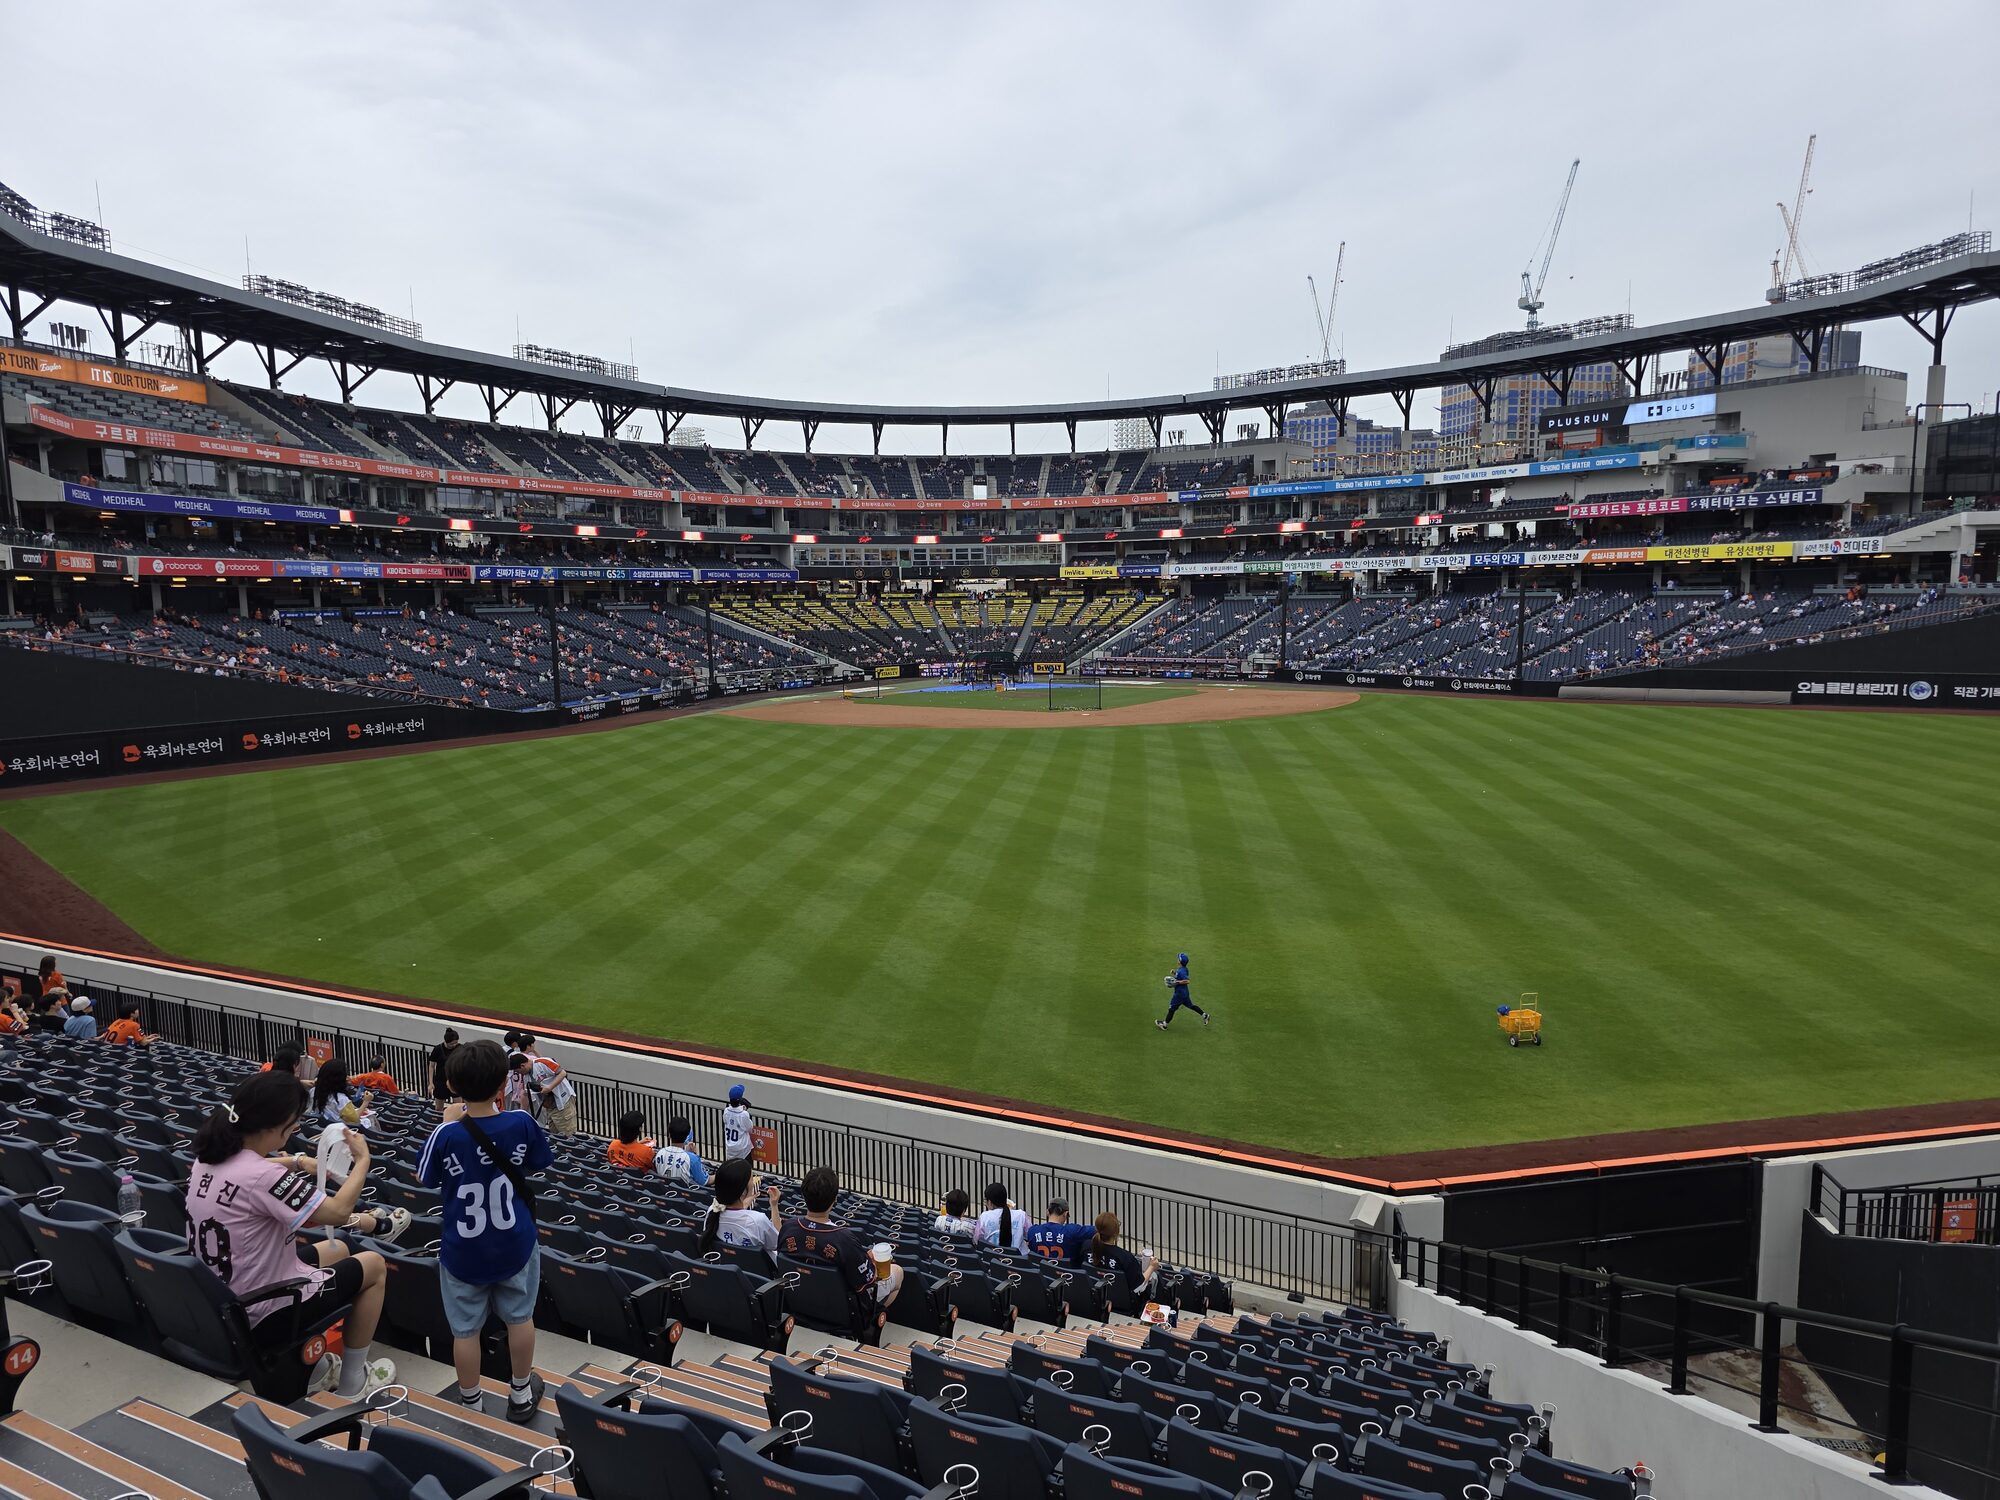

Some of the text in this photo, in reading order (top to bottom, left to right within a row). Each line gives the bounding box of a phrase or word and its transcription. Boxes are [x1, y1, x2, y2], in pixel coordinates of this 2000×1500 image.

[8, 353, 38, 372] TURN
[90, 368, 160, 392] IT IS OUR TURN
[1666, 403, 1696, 413] PLUS
[1540, 464, 1560, 472] BEYOND
[1572, 461, 1591, 470] WATER
[1443, 473, 1461, 482] BEYOND
[1470, 471, 1488, 479] WATER
[1336, 481, 1354, 490] BEYOND
[72, 489, 92, 501] MEDIHEAL
[102, 495, 146, 507] MEDIHEAL
[1699, 490, 1817, 509] 워터마크는 스냅태그
[174, 500, 213, 512] MEDIHEAL
[237, 506, 272, 516] MEDIHEAL
[1579, 500, 1680, 516] 포토카드는 포토코드
[295, 510, 327, 520] MEDIHEAL
[1664, 546, 1709, 558] 대전선병원
[1724, 544, 1775, 557] 유성선병원
[1804, 544, 1817, 554] 60년
[1843, 540, 1880, 553] 한미타올
[1424, 556, 1466, 566] 모두의 안과
[1474, 554, 1520, 565] 모두의 안과
[164, 562, 203, 570] roborock
[226, 563, 261, 571] roborock
[444, 567, 468, 578] TVING
[515, 569, 526, 578] 되는
[527, 569, 539, 578] 시간
[606, 570, 626, 578] GS25
[1414, 679, 1434, 688] 한화오션
[1797, 682, 1898, 696] 오늘 클립 챌린지
[1954, 686, 1978, 698] 직관
[363, 718, 425, 736] 육회바른연어
[260, 727, 331, 747] 육회바른연어
[144, 737, 224, 758] 육회바른연어
[8, 750, 100, 774] 육회바른연어
[656, 1154, 686, 1170] 이호성
[196, 1173, 241, 1208] 현진
[456, 1174, 516, 1239] 30
[1087, 1252, 1116, 1269] 강호
[786, 1318, 794, 1332] 10
[672, 1325, 680, 1339] 11
[307, 1340, 322, 1358] 13
[10, 1347, 32, 1370] 14
